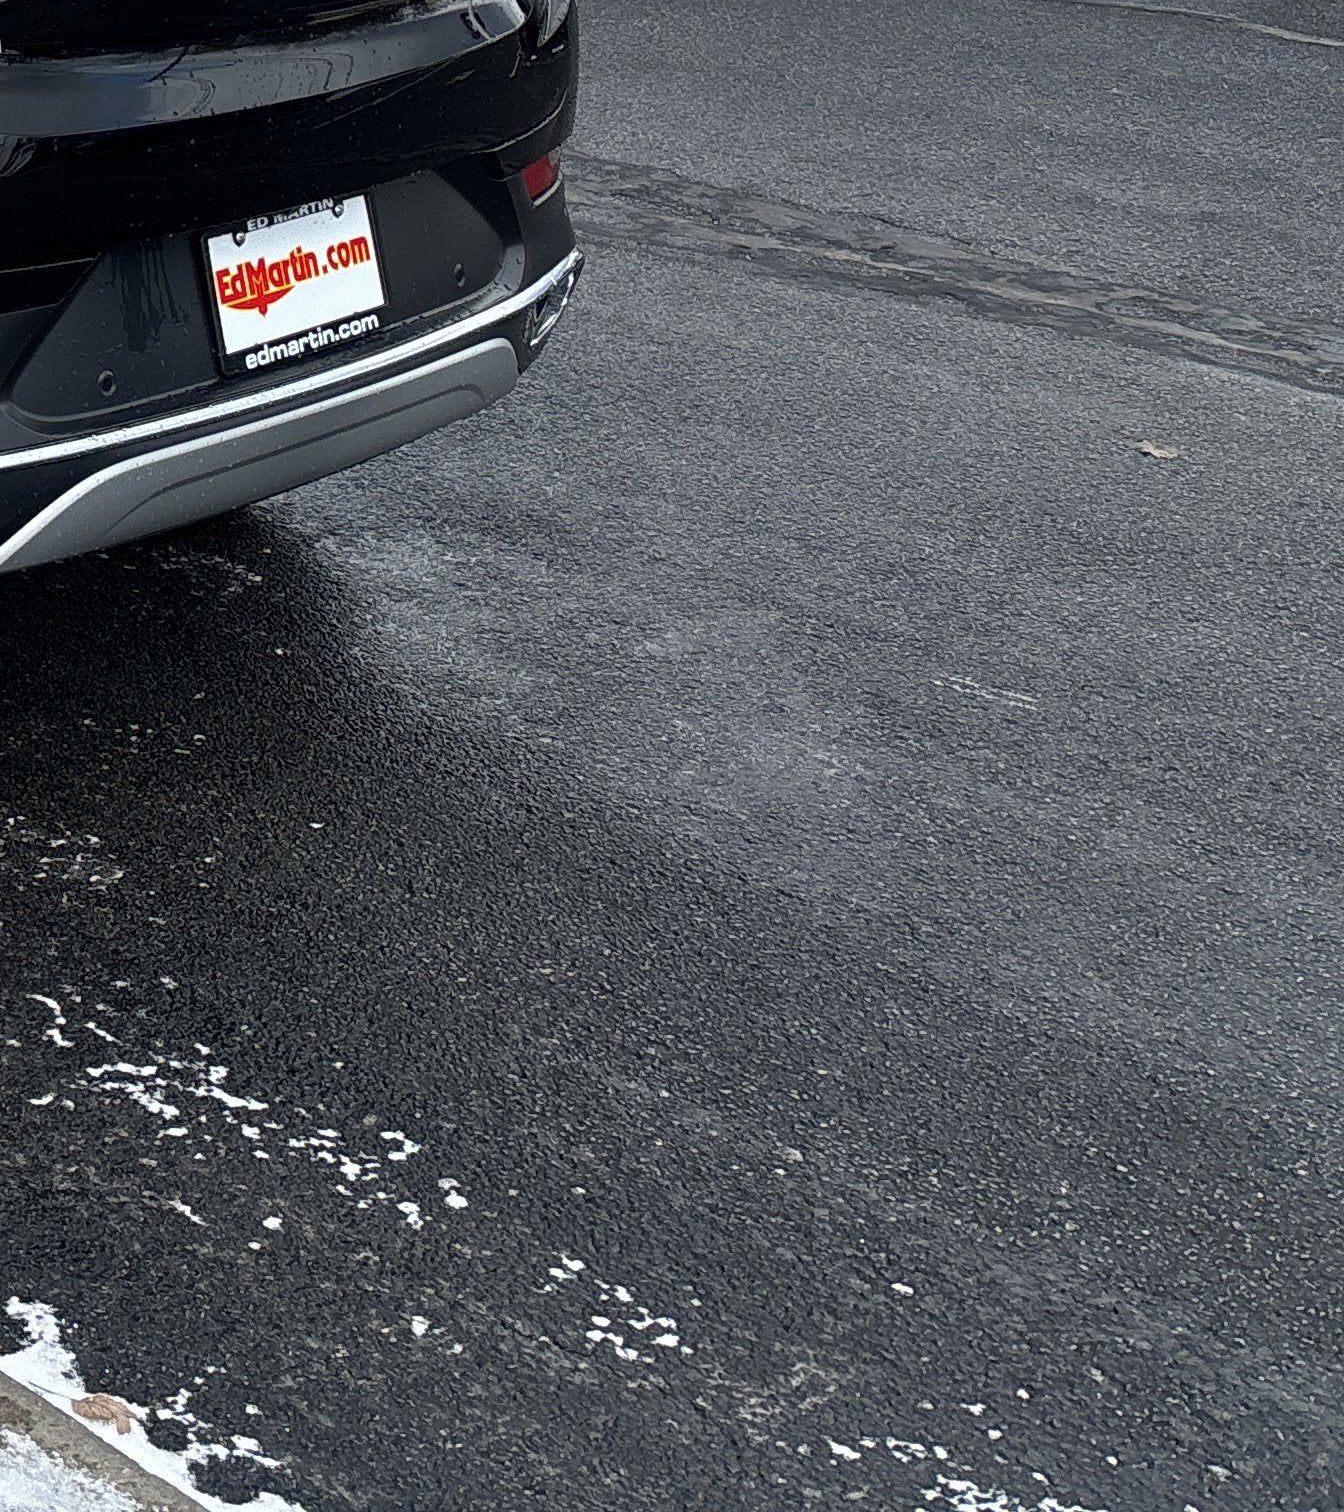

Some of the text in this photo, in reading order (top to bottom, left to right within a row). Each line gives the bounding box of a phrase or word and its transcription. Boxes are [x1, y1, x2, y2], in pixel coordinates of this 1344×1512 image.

[246, 197, 335, 232] ED MARTIN
[245, 313, 380, 370] edmartin.com
